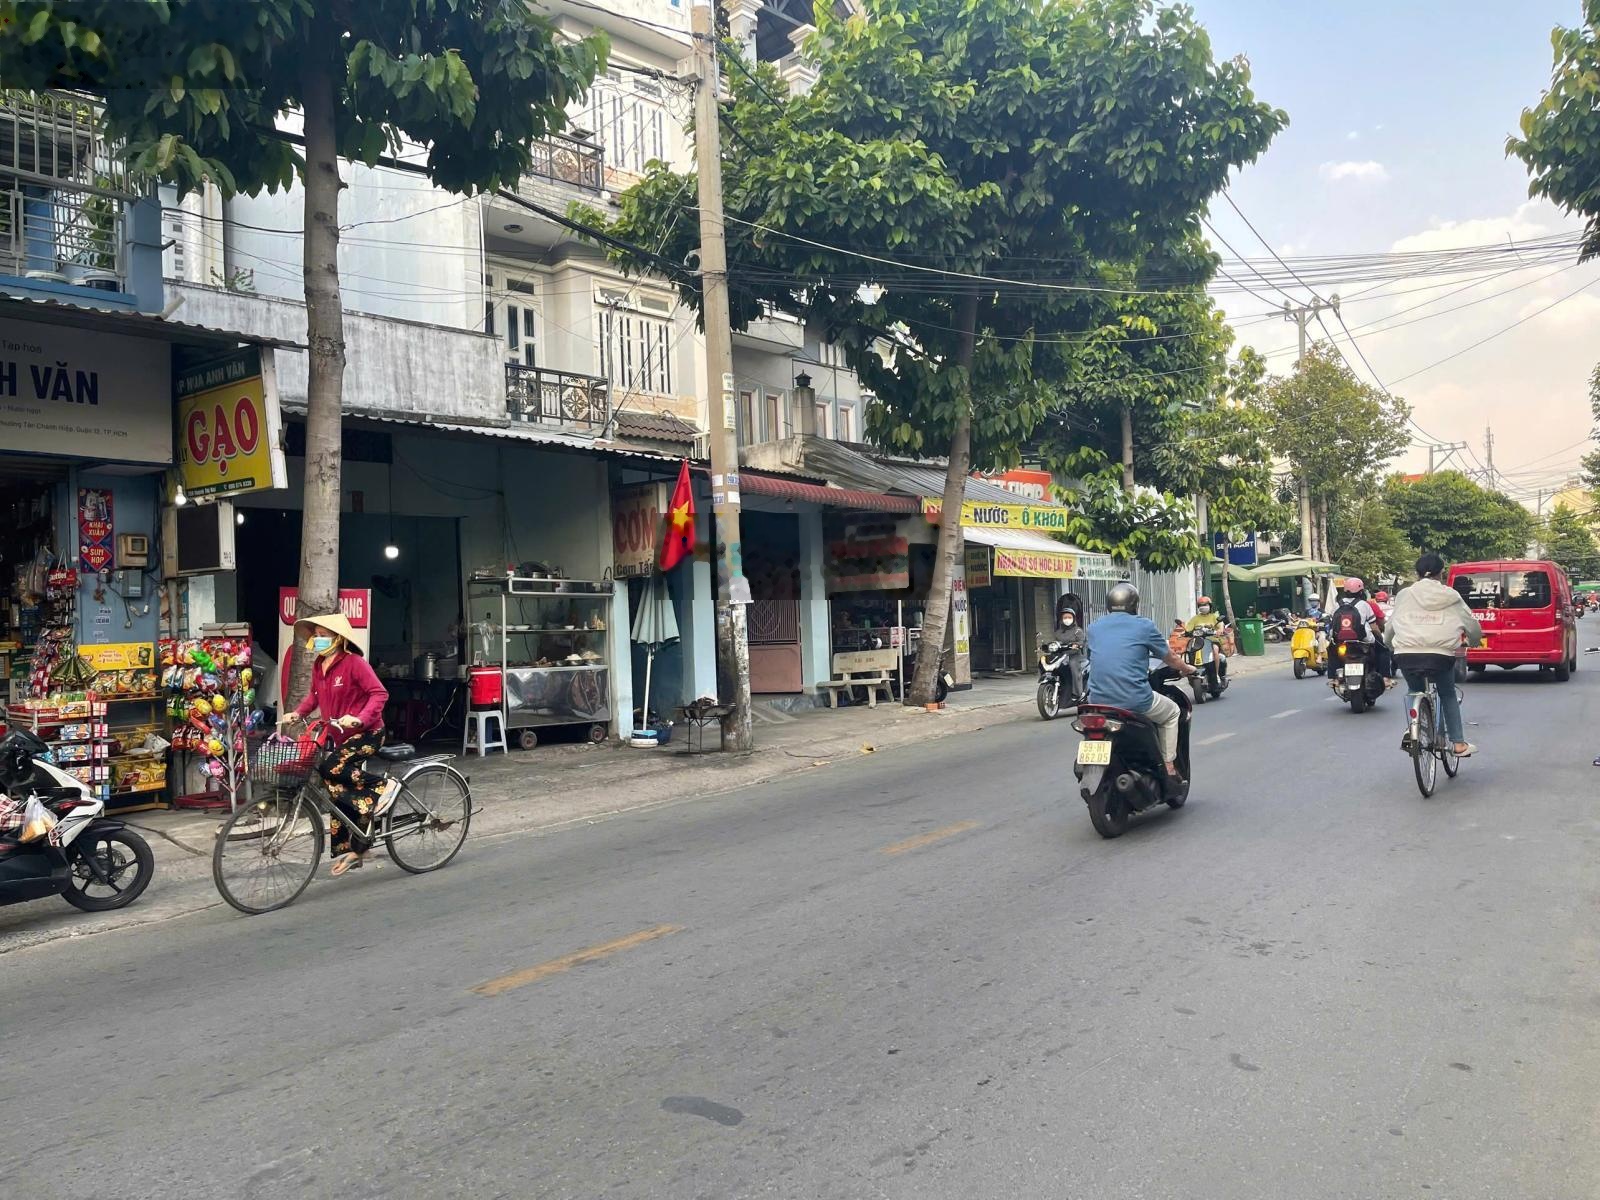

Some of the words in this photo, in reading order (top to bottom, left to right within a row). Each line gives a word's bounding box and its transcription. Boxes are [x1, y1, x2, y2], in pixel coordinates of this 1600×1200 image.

[30, 360, 98, 405] VĂN
[187, 395, 260, 476] GẠO
[973, 506, 1009, 524] NƯỚC
[1033, 509, 1065, 528] KHÓA
[89, 548, 104, 556] SUM
[1064, 559, 1073, 573] XE
